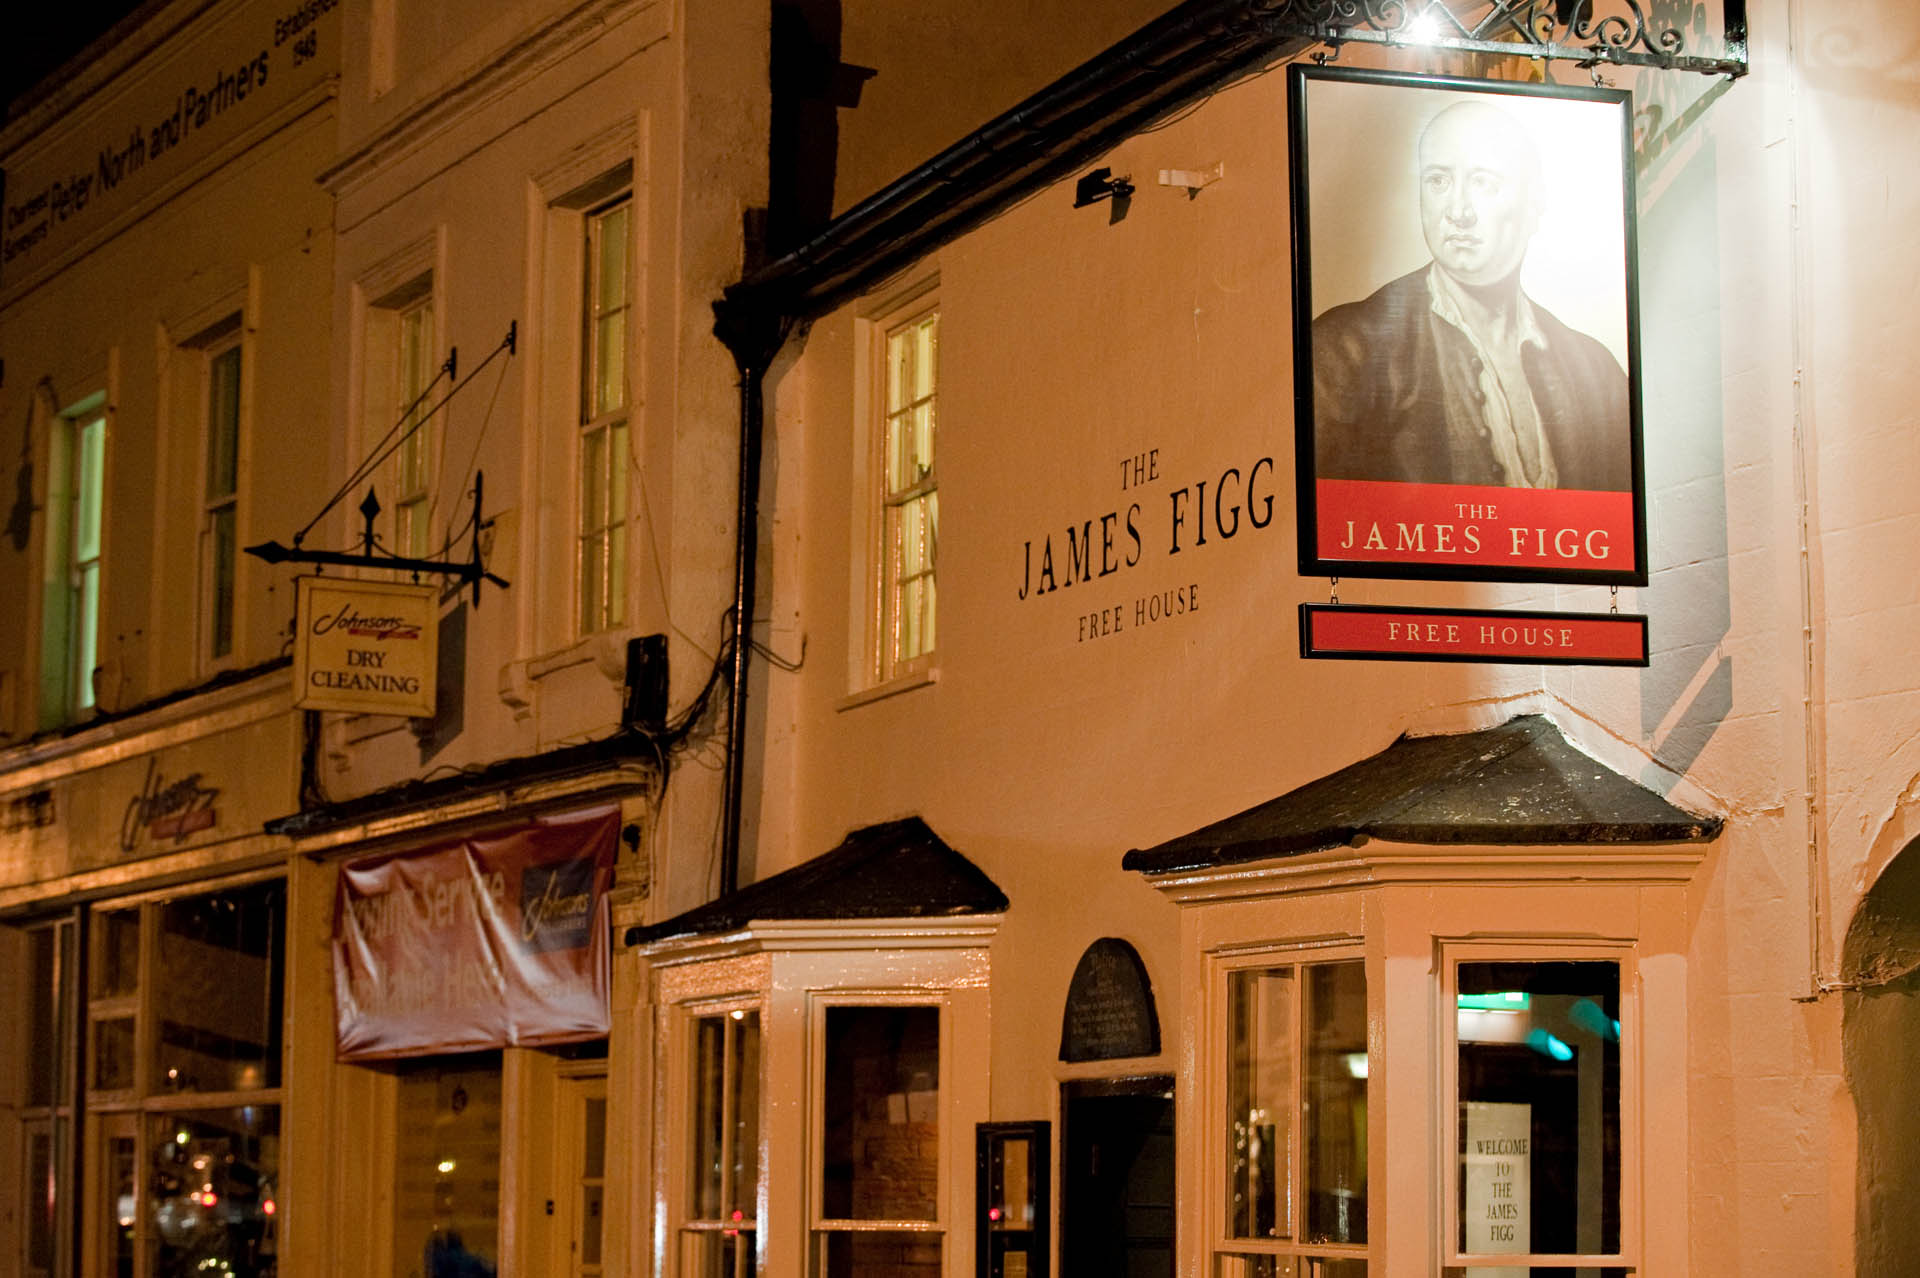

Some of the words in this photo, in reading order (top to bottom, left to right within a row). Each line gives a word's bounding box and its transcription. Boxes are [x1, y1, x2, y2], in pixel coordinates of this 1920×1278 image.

[98, 124, 146, 192] North
[150, 95, 182, 160] and
[183, 50, 269, 137] Partners
[1119, 448, 1160, 491] THE
[1454, 503, 1498, 520] THE
[1018, 503, 1142, 601] JAMES
[1169, 456, 1275, 555] FIGG
[1341, 520, 1481, 554] JAMES
[1508, 527, 1611, 560] FIGG
[312, 603, 423, 637] Johnsons
[1077, 605, 1123, 642] FREE
[1134, 583, 1200, 627] HOUSE
[1388, 621, 1461, 644] FREE
[1479, 625, 1574, 648] HOUSE
[346, 649, 386, 669] DRY
[311, 671, 420, 694] CLEANING
[1476, 1138, 1529, 1156] WELCOME
[1495, 1161, 1511, 1177] TO
[1491, 1182, 1513, 1199] THE
[1486, 1203, 1518, 1220] JAMES
[1490, 1224, 1515, 1242] FIGG
